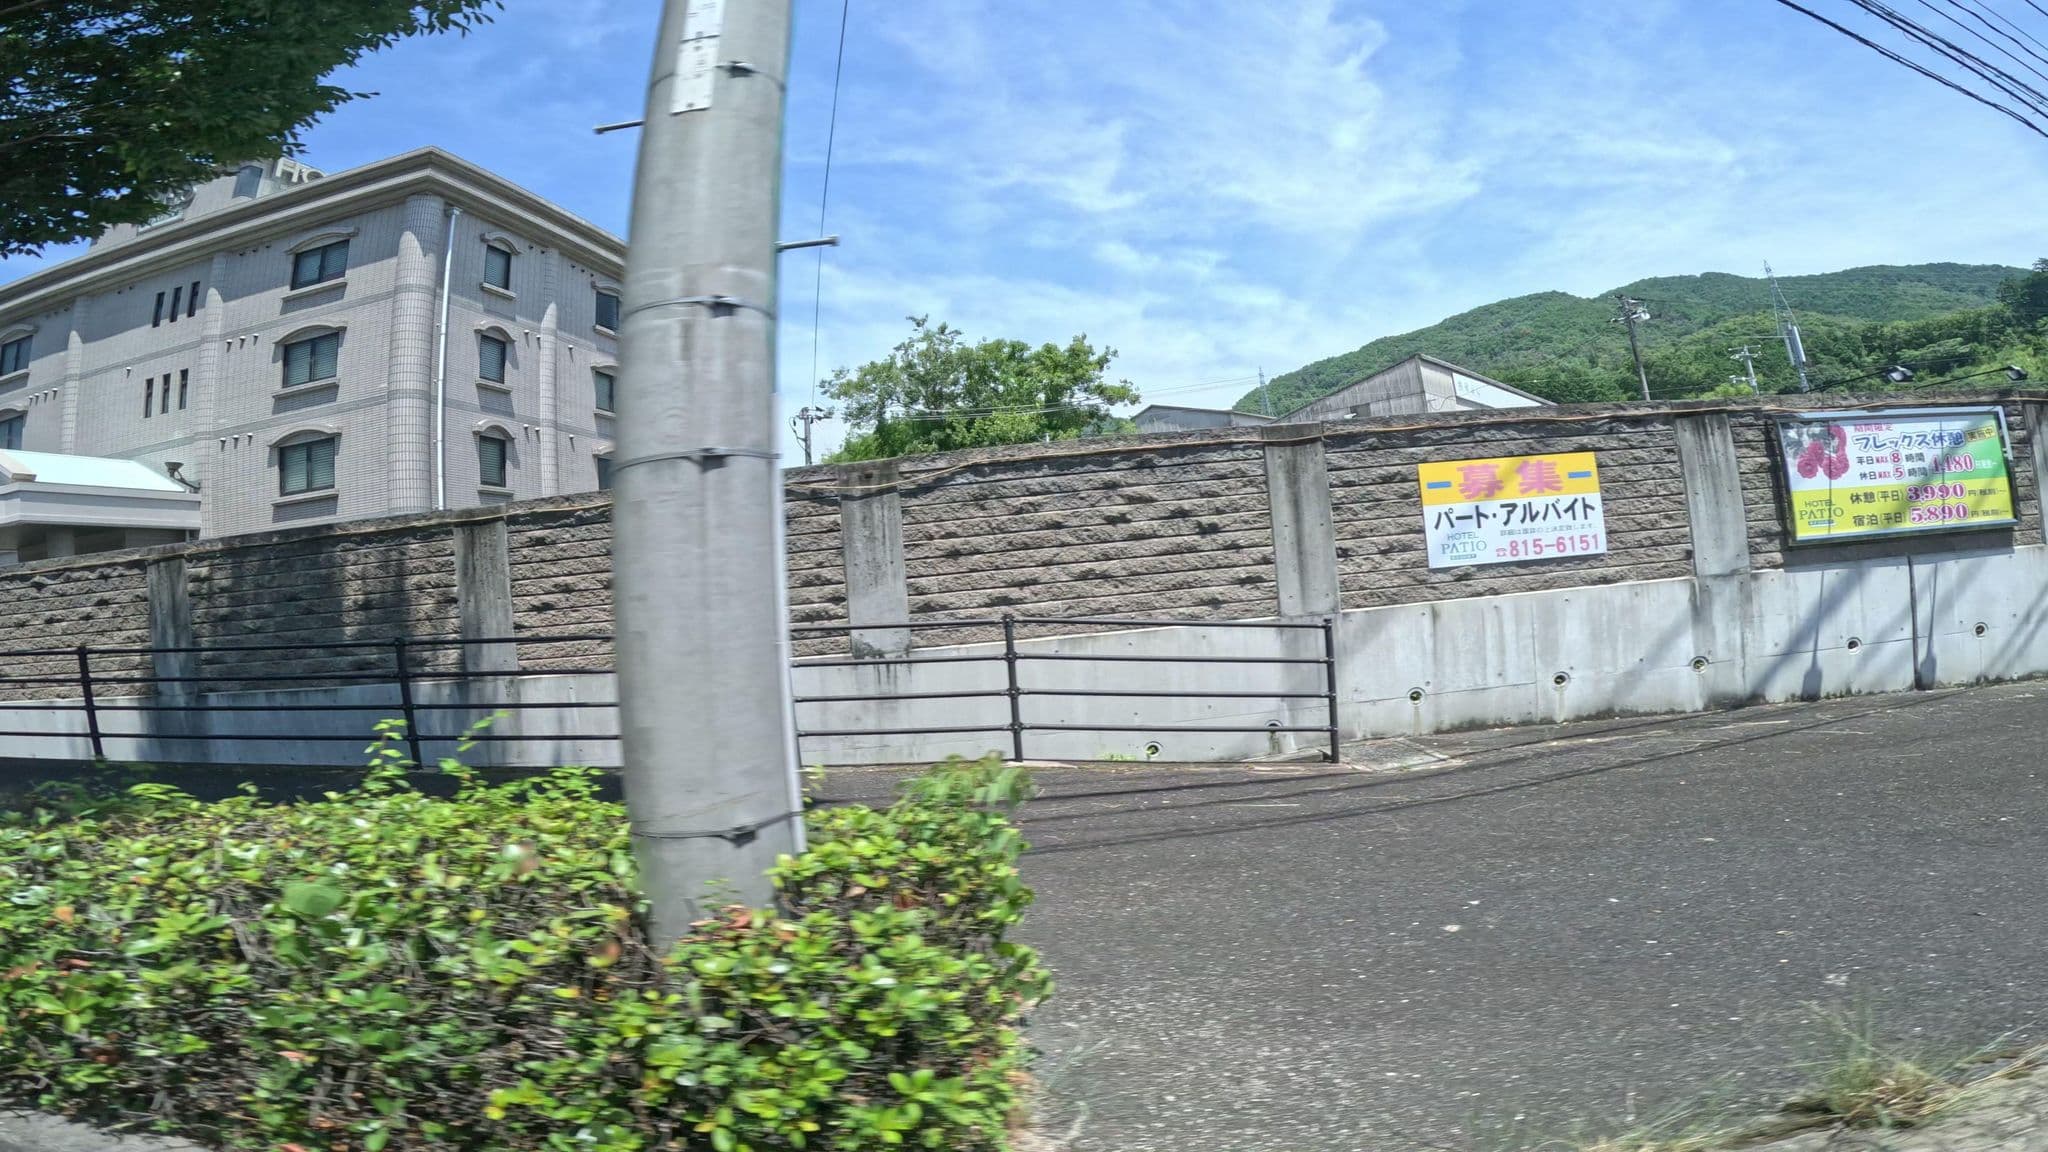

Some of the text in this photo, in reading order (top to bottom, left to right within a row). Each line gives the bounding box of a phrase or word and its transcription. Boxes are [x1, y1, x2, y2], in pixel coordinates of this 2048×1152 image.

[1854, 430, 1964, 450] フレックス休憩
[1456, 460, 1564, 500] 募集
[1907, 484, 1966, 502] 3,990
[1805, 499, 1836, 508] HOTEL
[1434, 497, 1596, 530] パート・アルバイト
[1799, 507, 1844, 520] PATIO
[1447, 531, 1479, 541] HOTEL
[1509, 533, 1600, 557] 815-6151
[1441, 540, 1488, 555] PATIO
